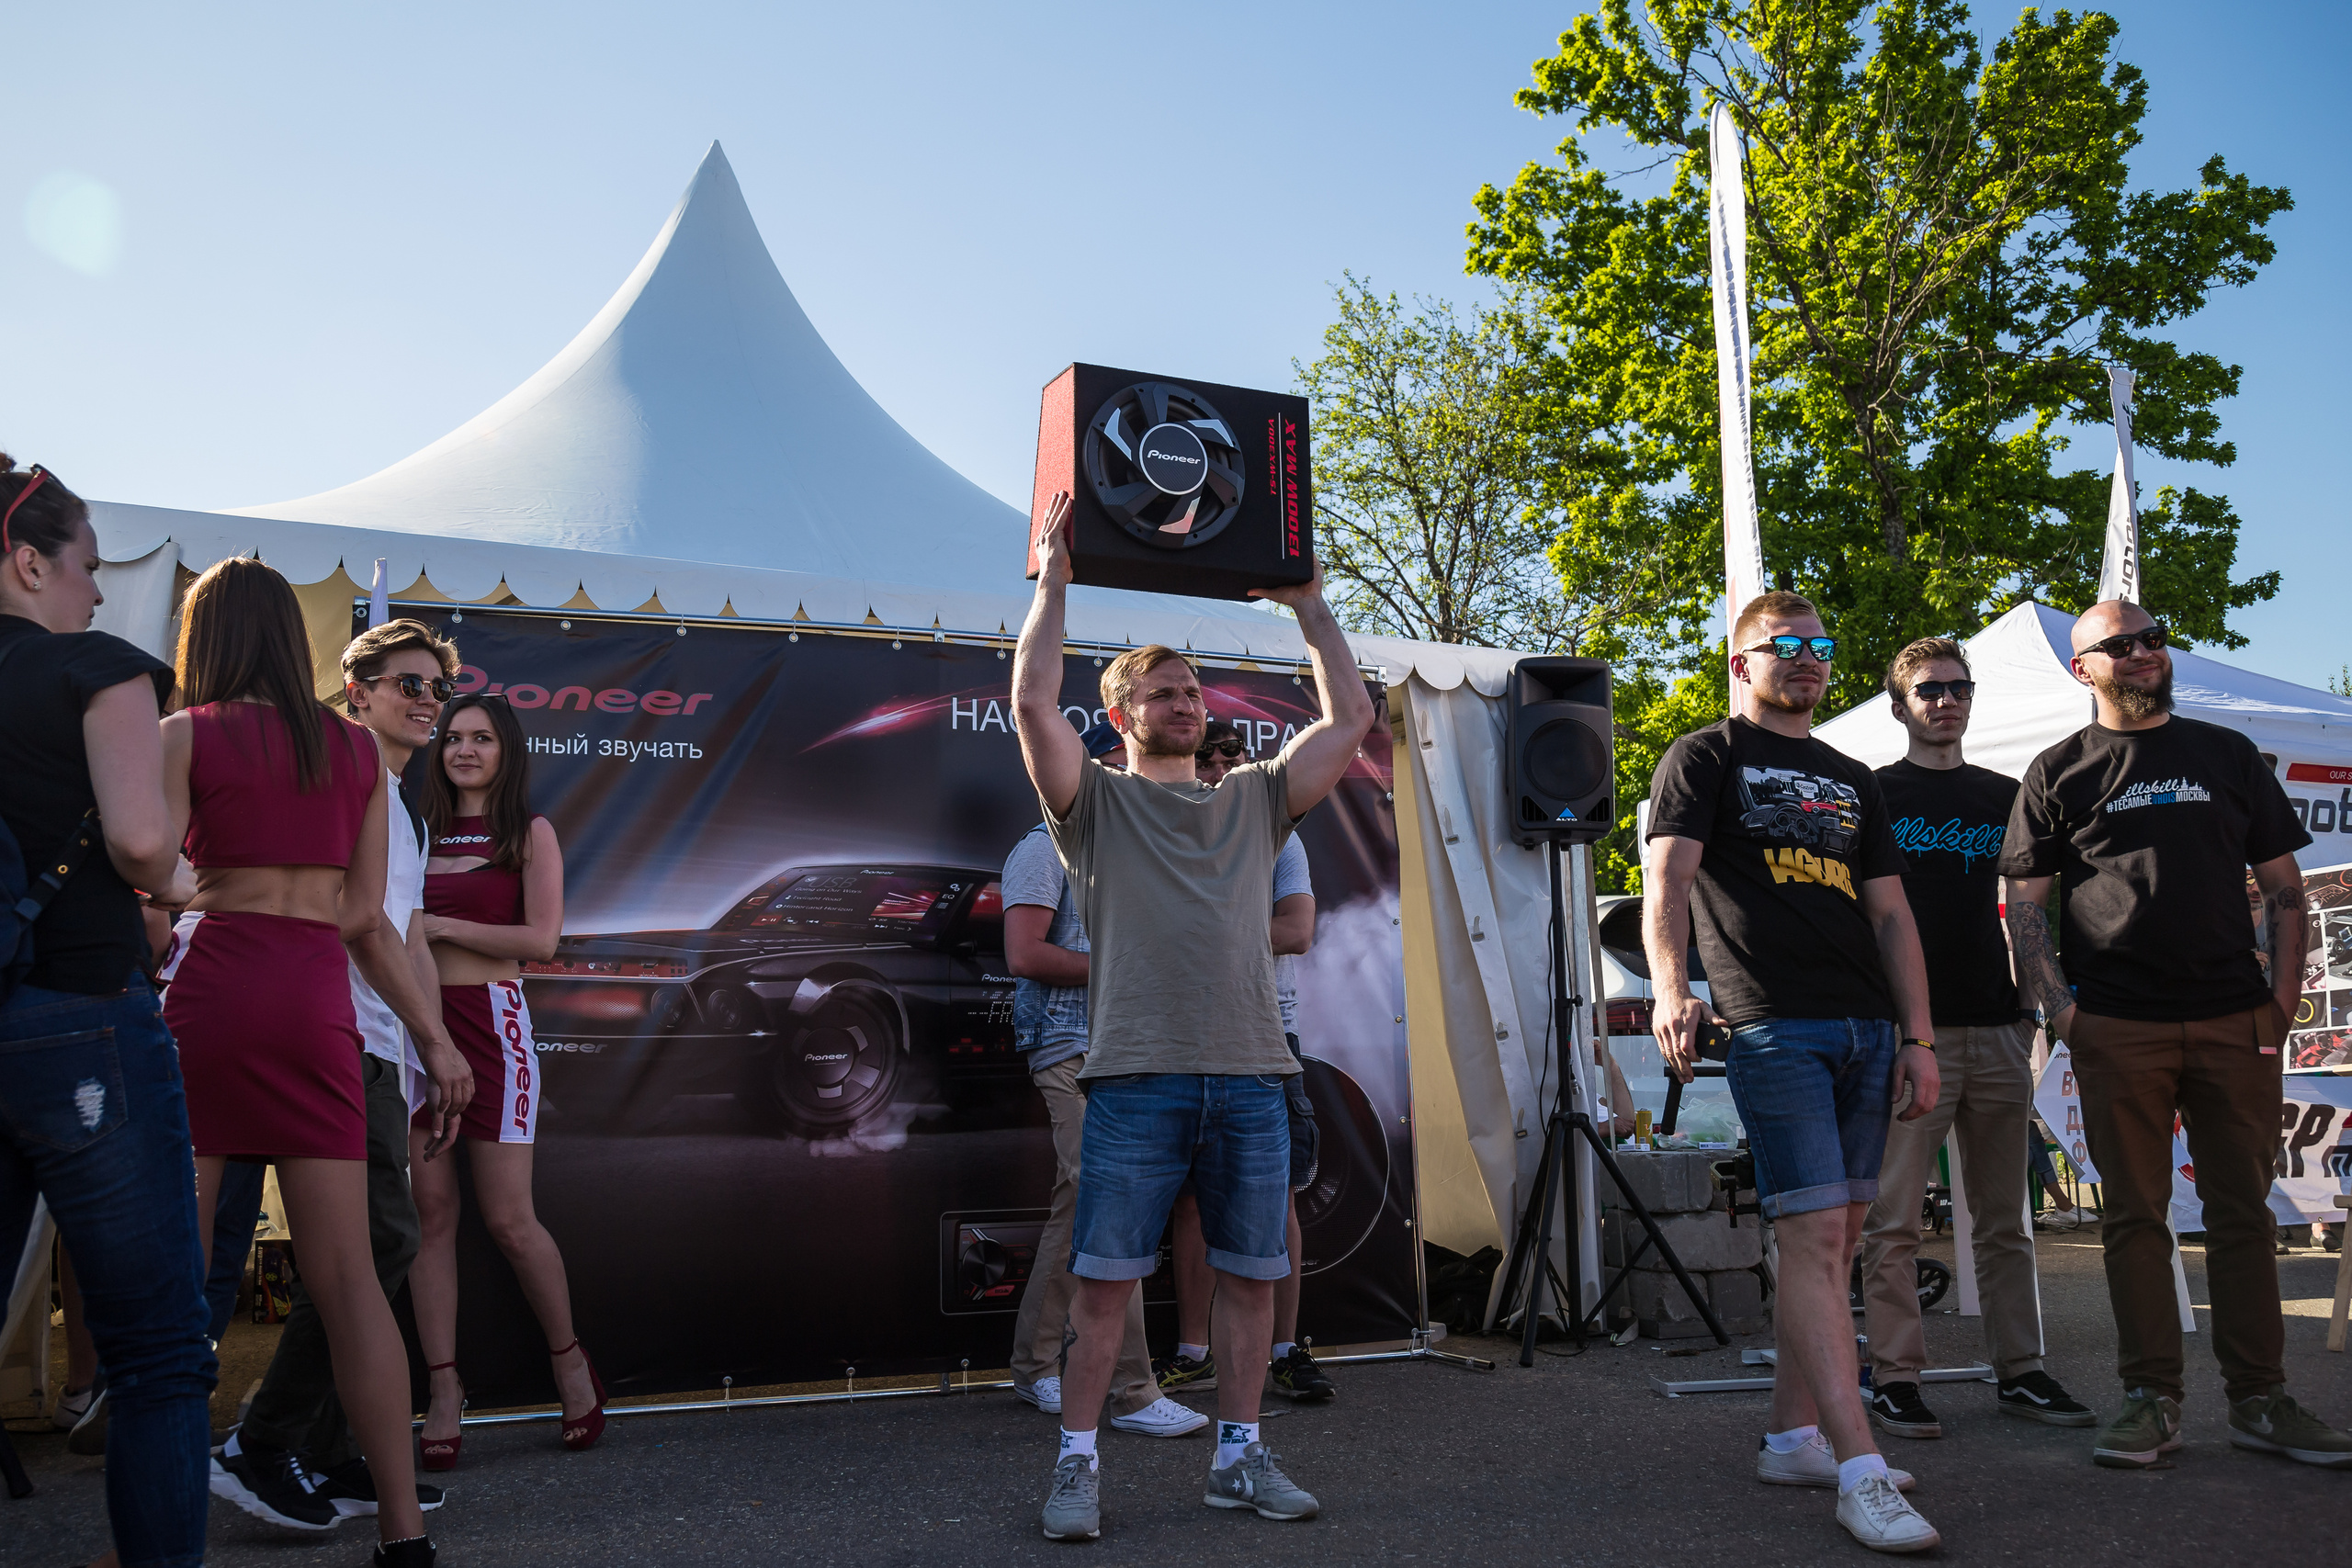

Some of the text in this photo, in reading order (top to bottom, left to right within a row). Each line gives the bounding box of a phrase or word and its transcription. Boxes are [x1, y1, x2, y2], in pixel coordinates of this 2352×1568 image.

[1147, 449, 1201, 465] Pioneer
[1268, 419, 1276, 495] TS-WX300A
[1285, 419, 1300, 558] 1300W MAX
[598, 738, 704, 762] звучать
[2329, 771, 2346, 780] OUR
[2125, 778, 2179, 797] illskill
[809, 876, 857, 888] USB
[536, 1042, 608, 1054] oneer
[497, 980, 531, 1137] Pioneer
[804, 1053, 848, 1062] Pioneer
